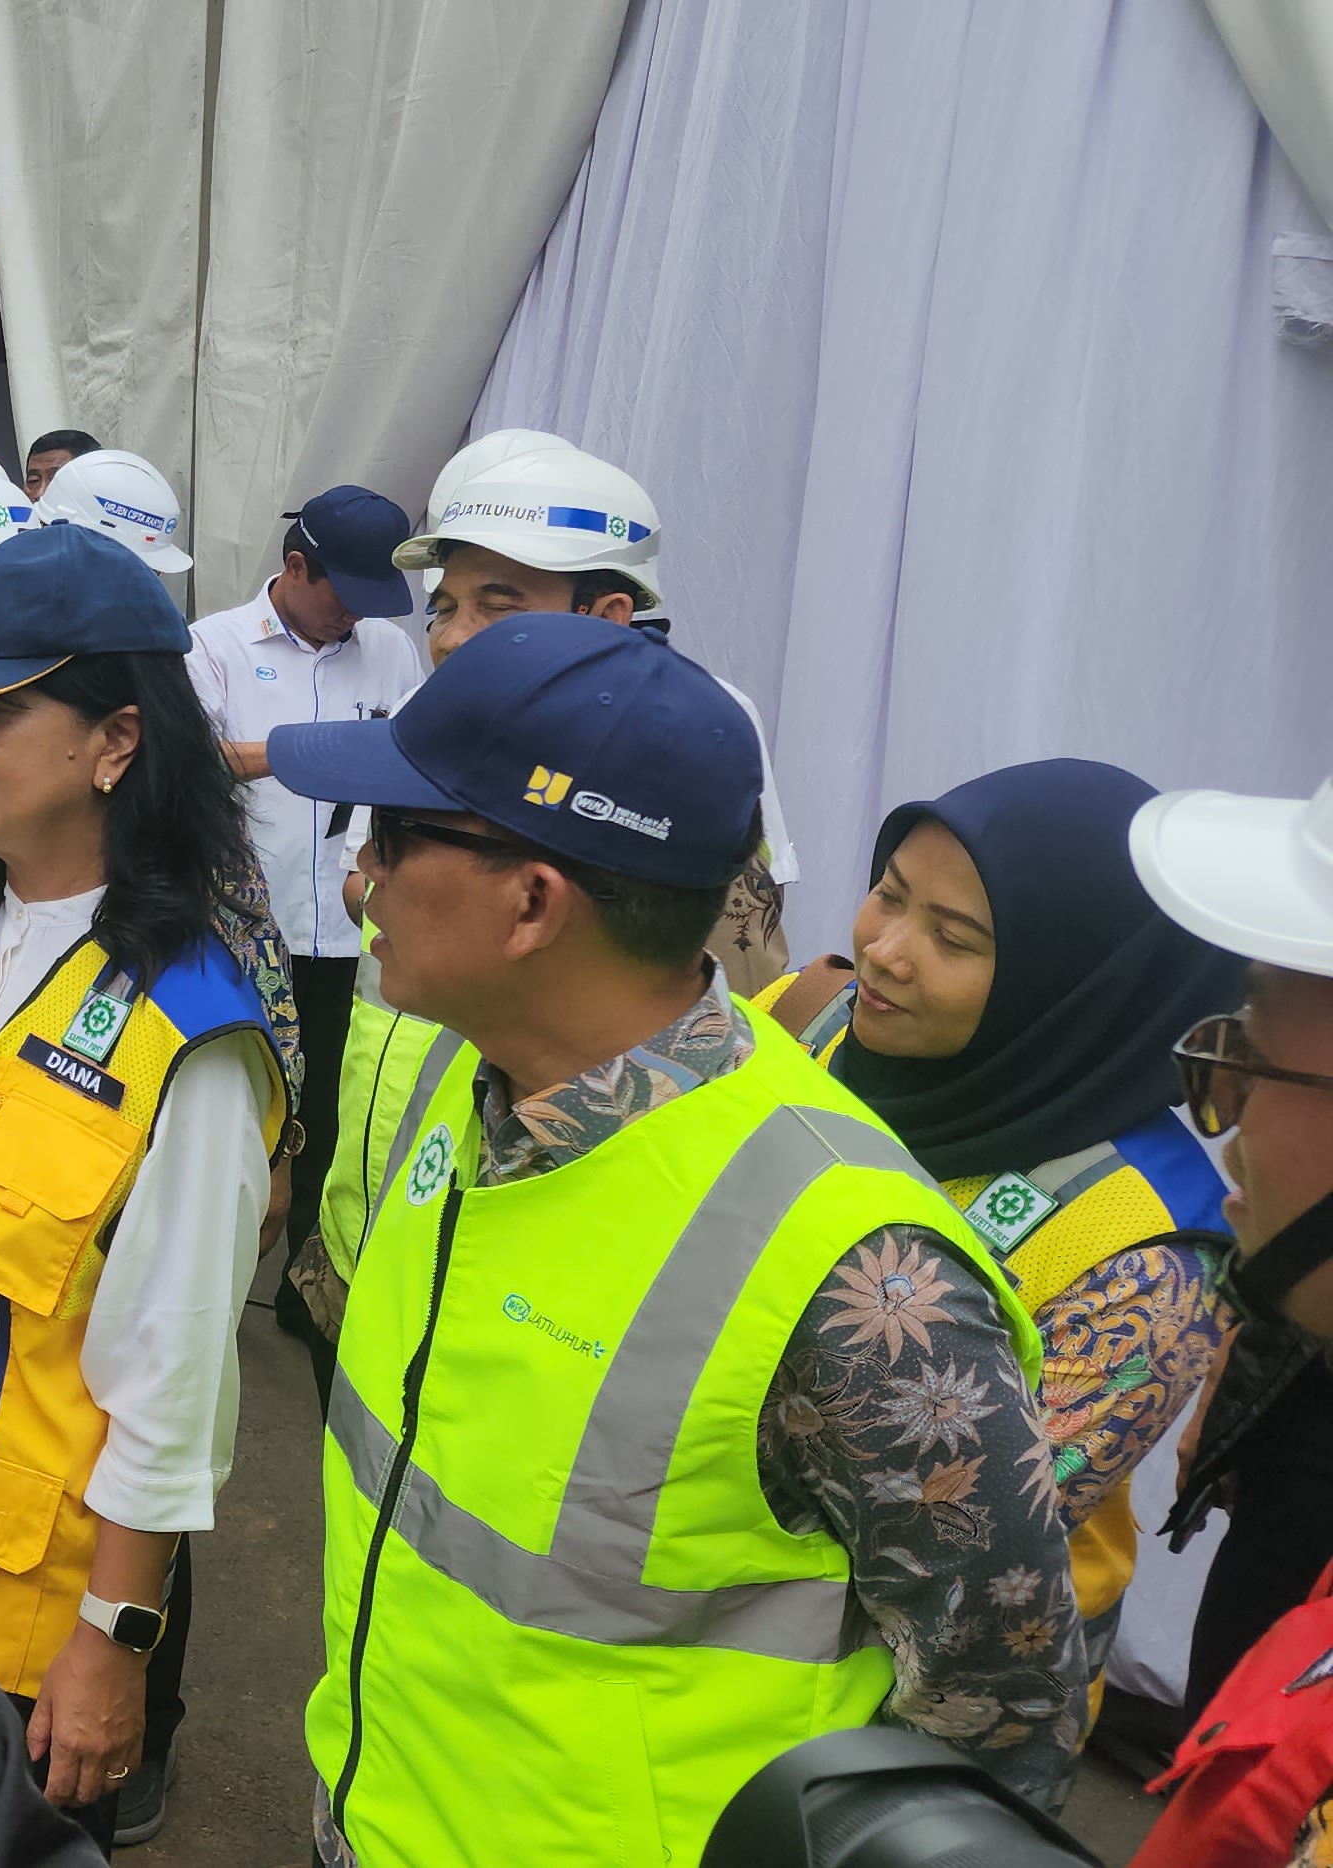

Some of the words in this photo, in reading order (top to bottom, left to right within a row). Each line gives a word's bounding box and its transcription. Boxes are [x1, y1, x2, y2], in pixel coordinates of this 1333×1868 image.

[459, 503, 537, 521] JATILUHUR
[45, 1050, 102, 1094] DIANA
[527, 1311, 593, 1358] JATILUHUR
